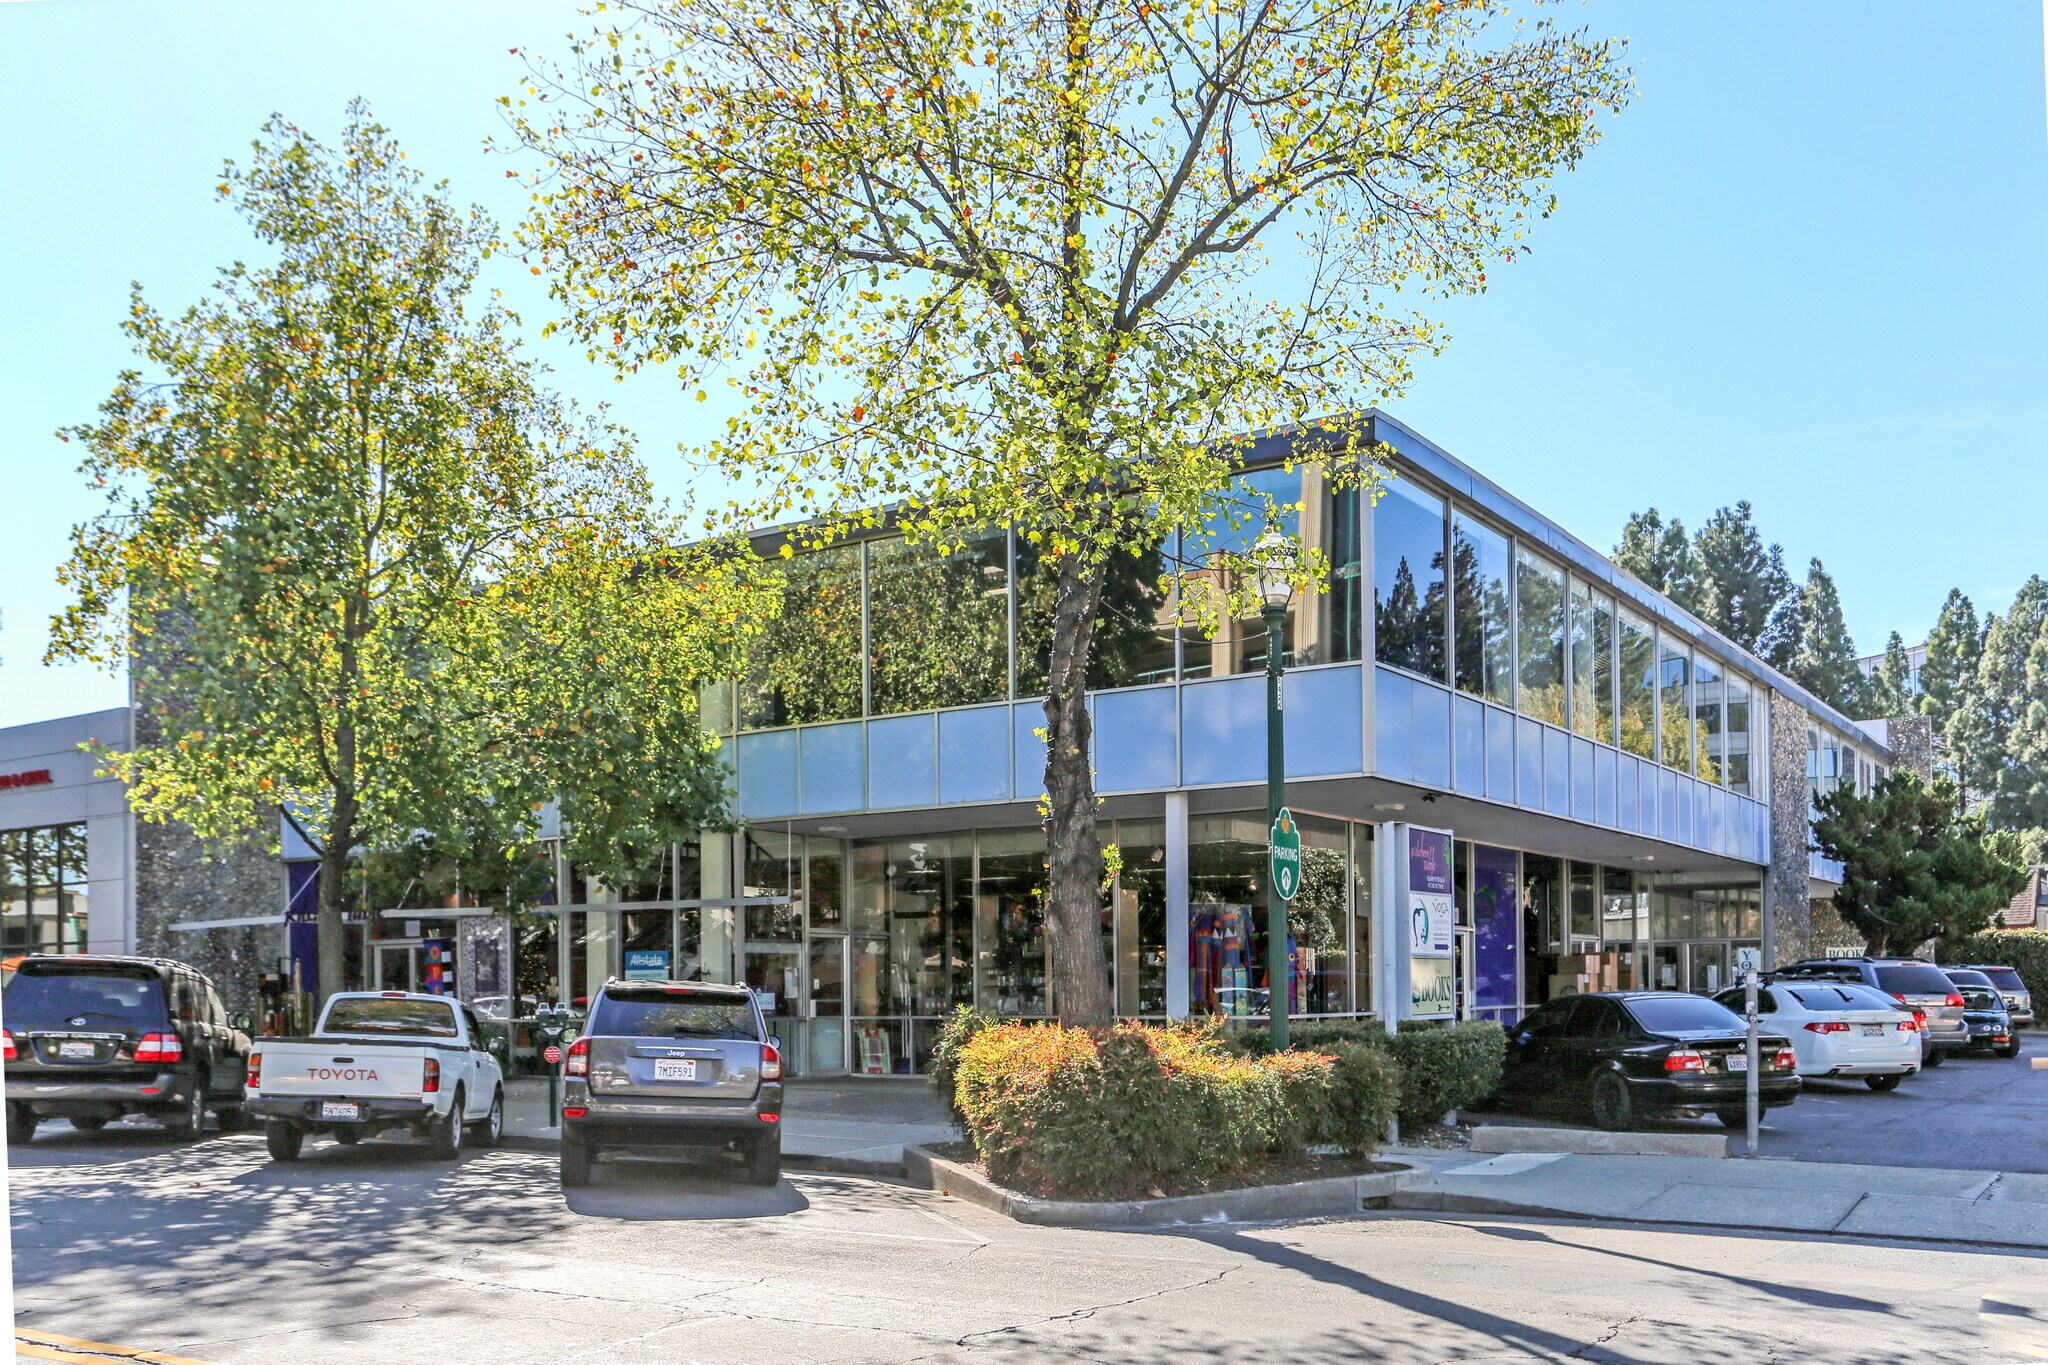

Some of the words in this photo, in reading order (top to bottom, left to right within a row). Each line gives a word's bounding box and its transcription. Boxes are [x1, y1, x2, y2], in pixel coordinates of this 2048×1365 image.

[1274, 845, 1298, 862] PARKING
[1432, 901, 1450, 914] YOGA
[629, 954, 664, 967] Allstate
[1421, 976, 1451, 1001] BOOKS
[667, 1050, 686, 1058] Jeep
[307, 1068, 379, 1082] TOYOTA
[657, 1066, 693, 1078] 7MIF591
